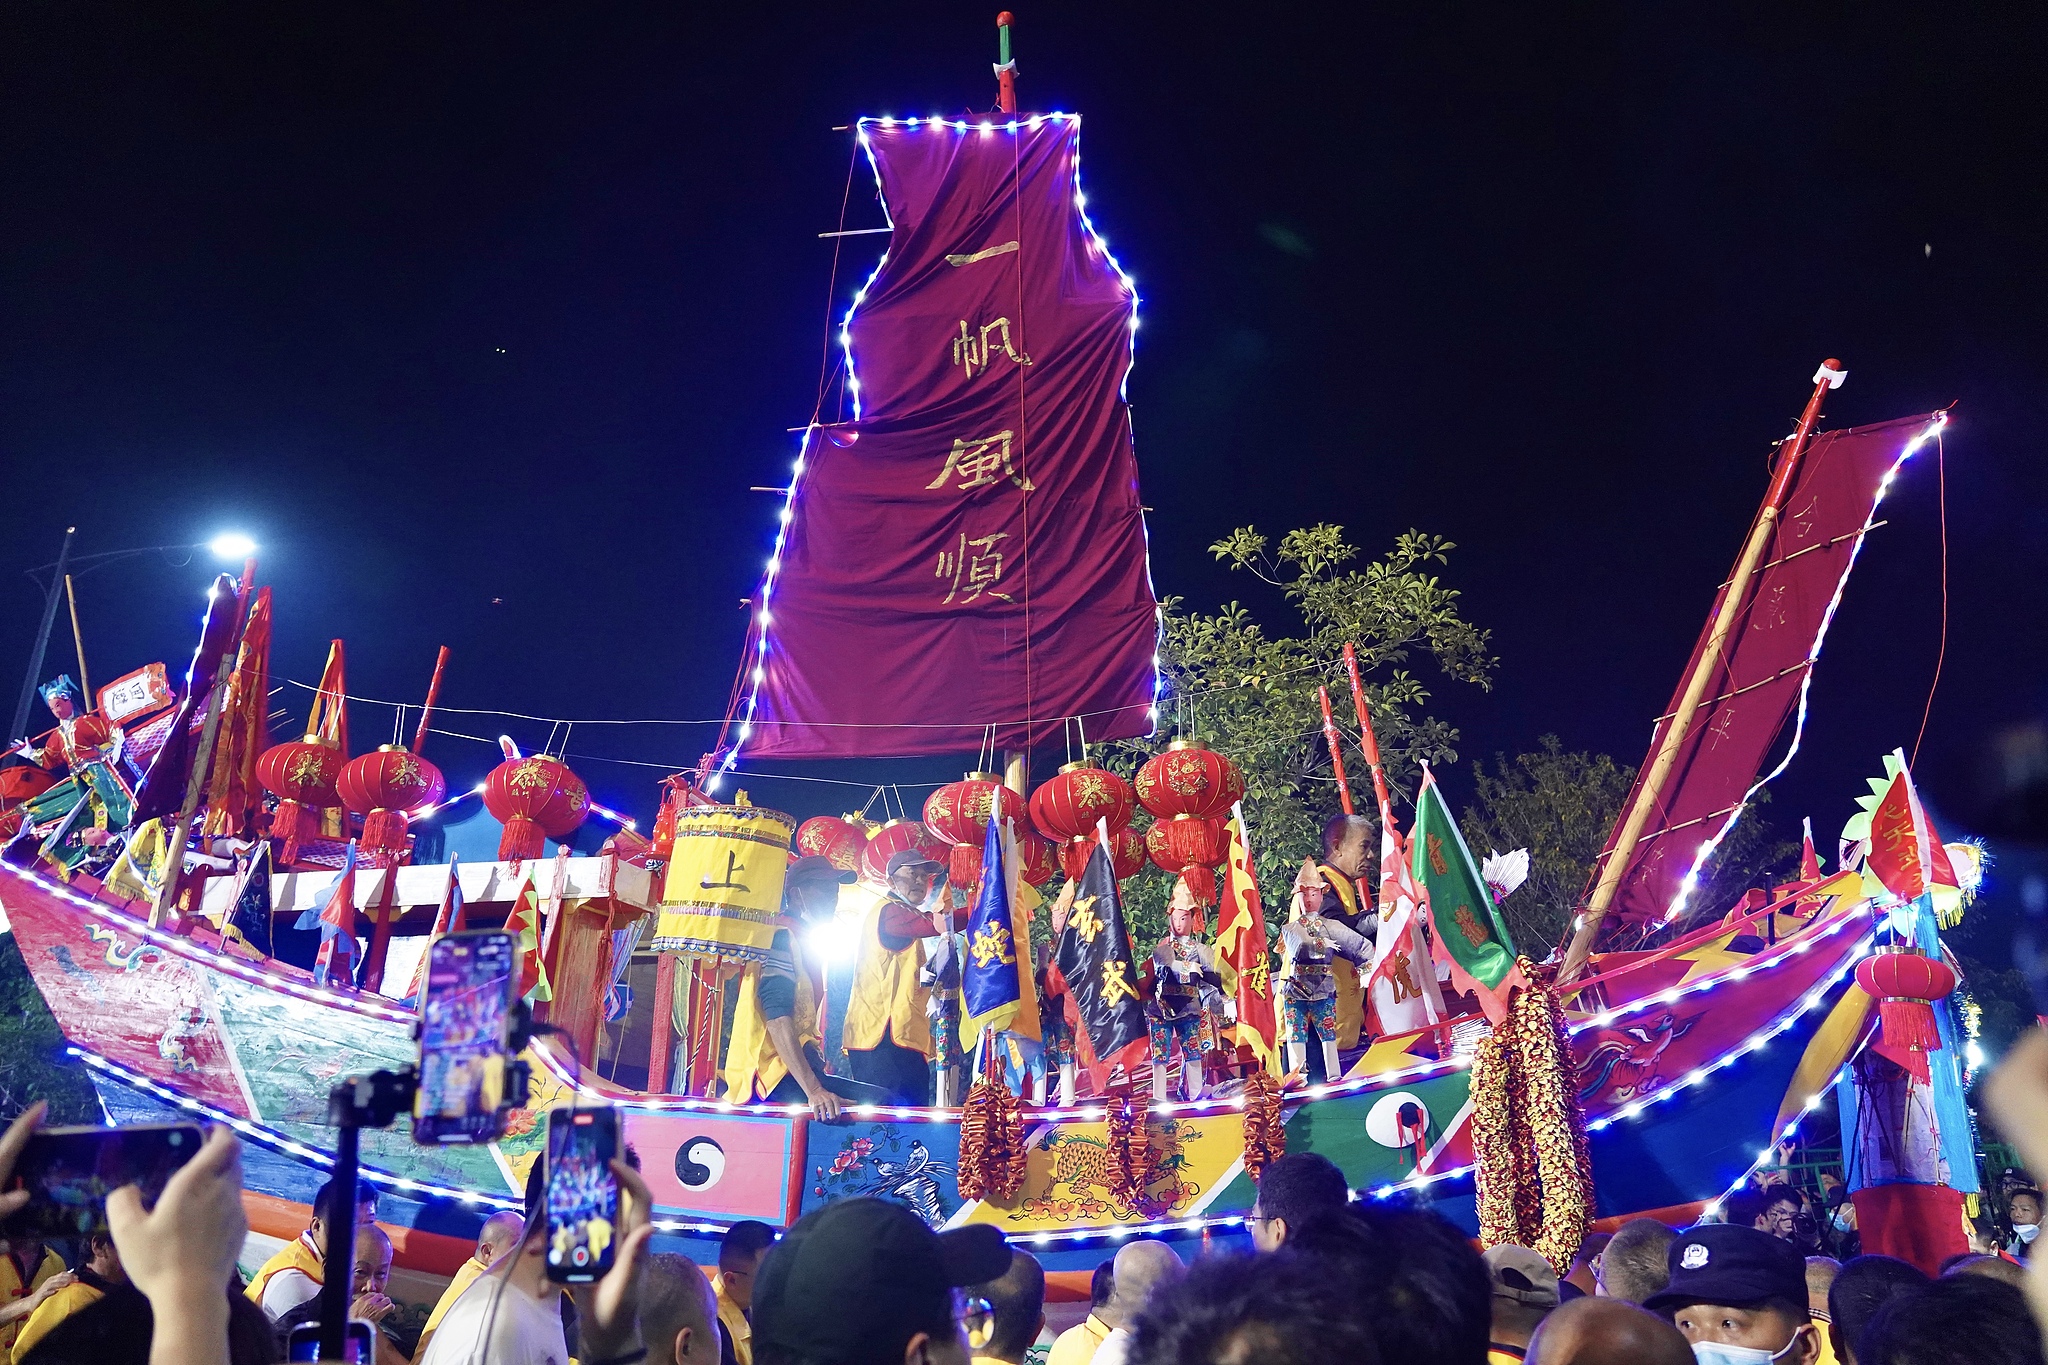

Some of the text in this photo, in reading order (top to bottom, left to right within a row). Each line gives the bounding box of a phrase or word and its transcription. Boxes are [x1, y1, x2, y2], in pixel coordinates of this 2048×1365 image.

[925, 240, 1035, 606] 一帆風順
[700, 849, 751, 893] 上
